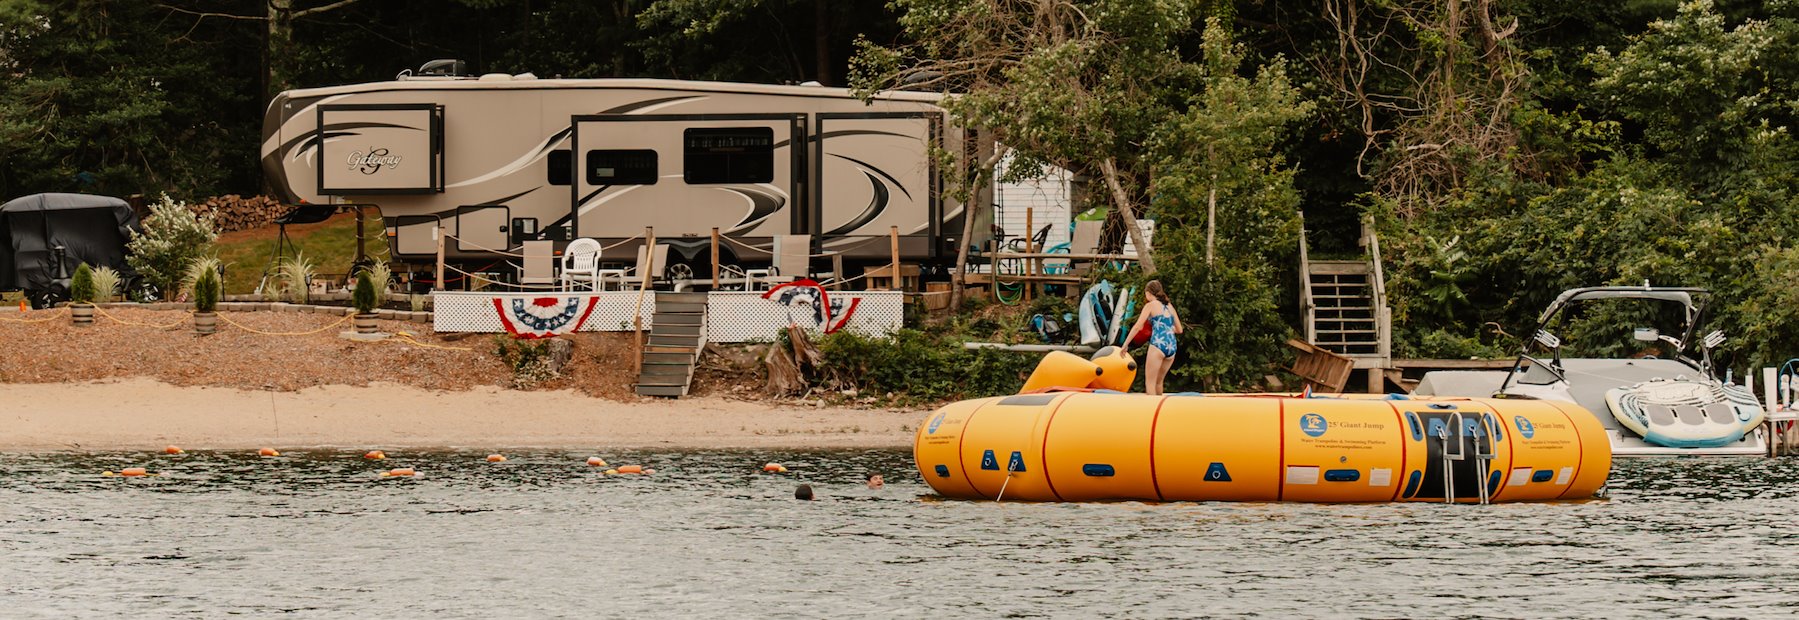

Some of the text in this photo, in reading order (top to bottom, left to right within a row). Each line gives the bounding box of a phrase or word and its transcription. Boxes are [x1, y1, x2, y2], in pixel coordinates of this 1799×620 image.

[346, 151, 402, 171] Gateway
[1340, 421, 1361, 429] Giant
[1363, 422, 1385, 430] Jump
